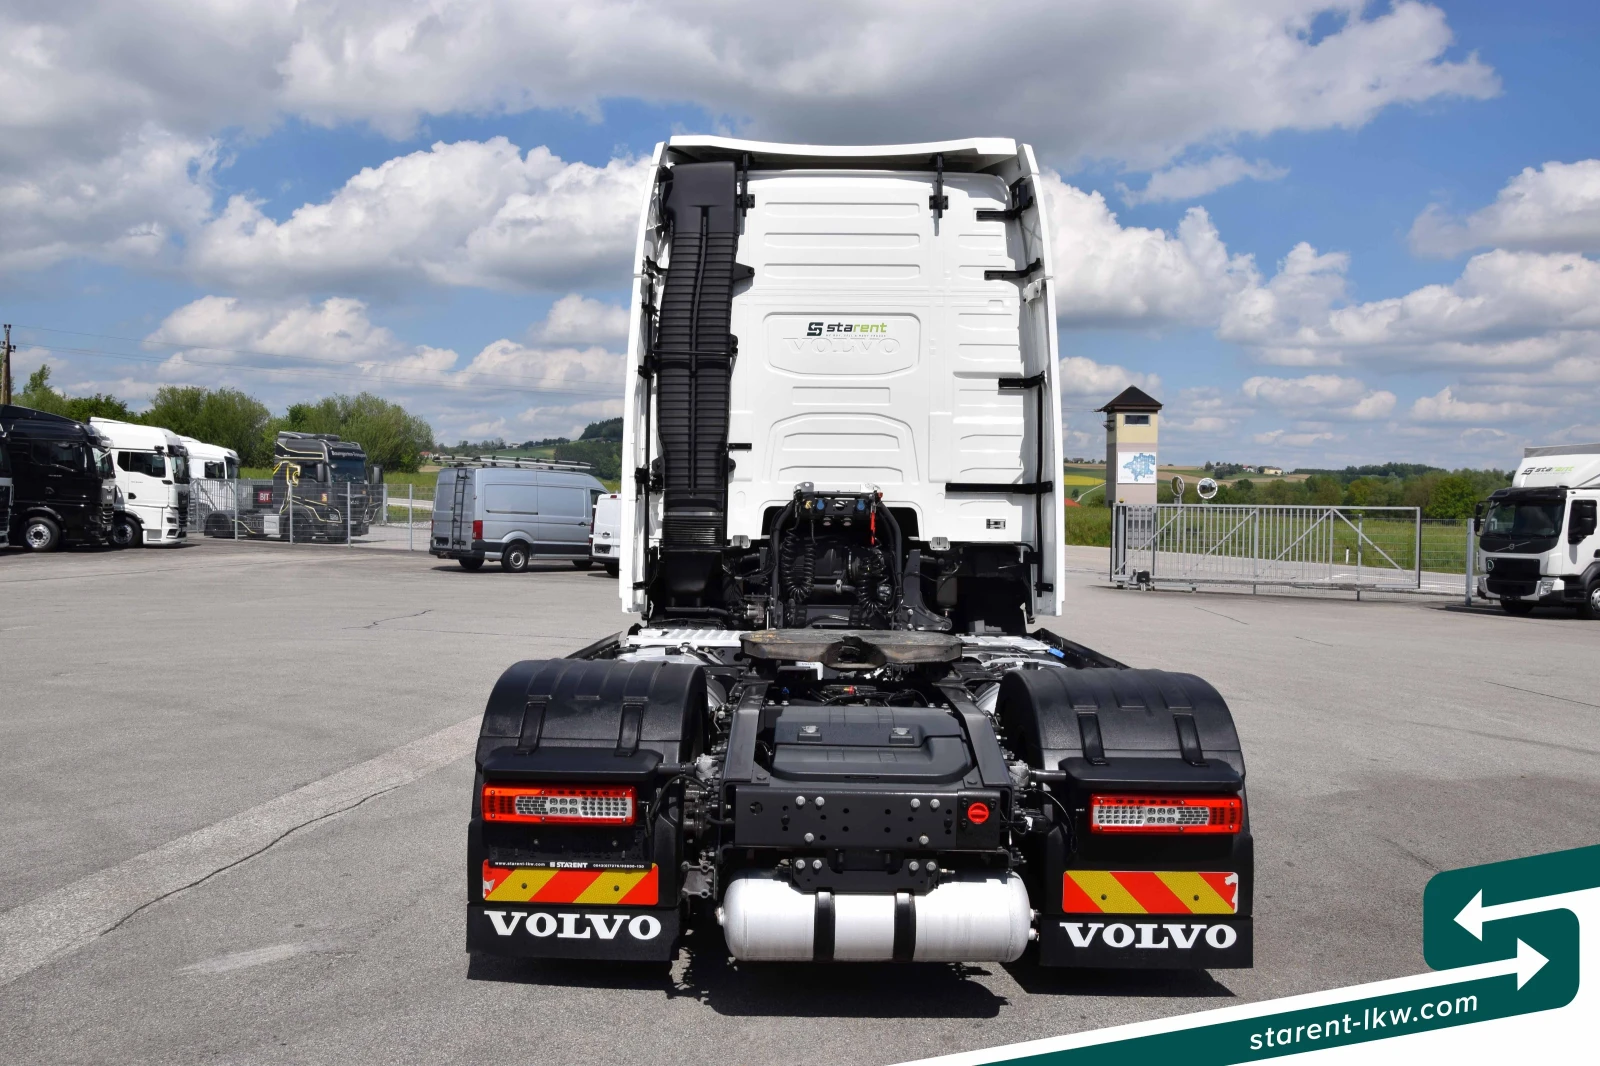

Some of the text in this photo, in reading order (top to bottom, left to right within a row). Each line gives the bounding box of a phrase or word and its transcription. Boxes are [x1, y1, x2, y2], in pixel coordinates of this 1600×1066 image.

[826, 322, 888, 333] starent
[783, 337, 901, 355] VOLVO
[484, 910, 662, 940] VOLVO
[1059, 922, 1237, 949] VOLVO
